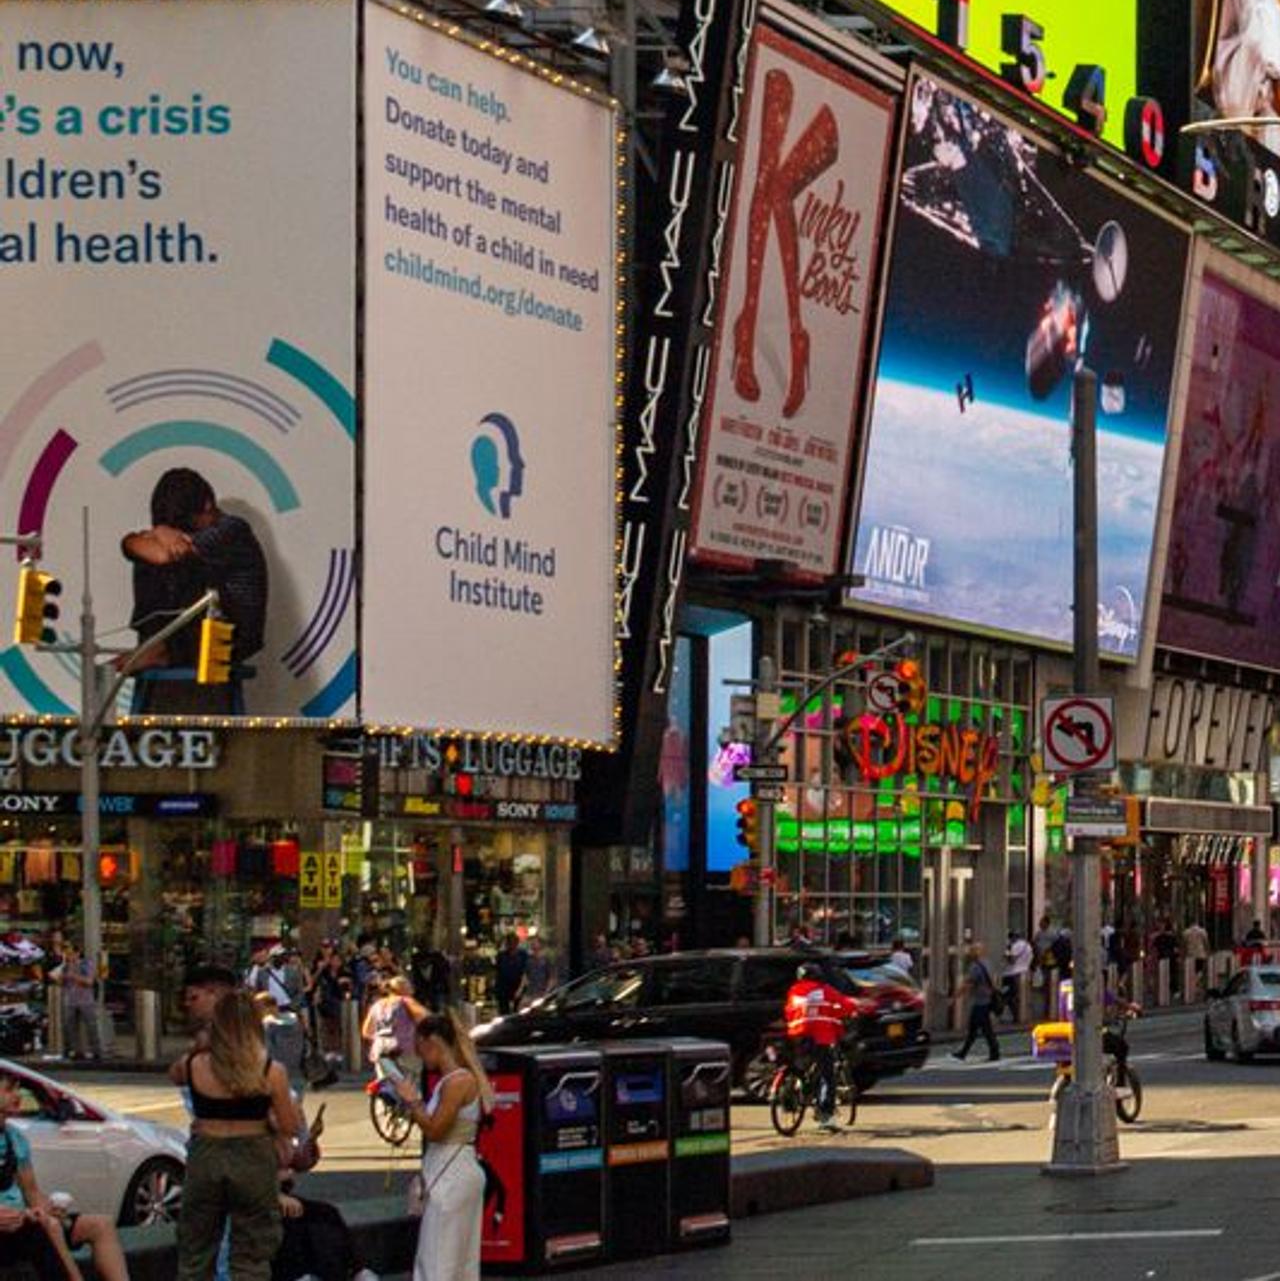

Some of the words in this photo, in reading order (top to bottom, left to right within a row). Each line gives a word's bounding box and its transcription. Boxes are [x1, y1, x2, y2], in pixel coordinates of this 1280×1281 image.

[17, 40, 124, 78] now,
[385, 46, 421, 85] You
[427, 72, 462, 103] can
[467, 83, 512, 123] help.
[55, 106, 82, 134] a
[97, 94, 231, 135] crisis
[385, 96, 457, 148] Donate
[461, 130, 513, 176] today
[516, 154, 549, 184] and
[385, 152, 462, 199] support
[467, 180, 496, 211] the
[501, 196, 561, 234] mental
[56, 224, 218, 263] health.
[385, 194, 448, 241] health
[452, 223, 472, 248] of
[476, 234, 487, 254] a
[490, 236, 535, 270] child
[539, 251, 555, 278] in
[558, 263, 600, 293] need
[384, 247, 583, 332] childmind.org/donate
[435, 526, 498, 566] Child
[502, 537, 556, 579] Mind
[864, 524, 930, 589] ANDOR
[449, 570, 544, 616] Institute
[463, 739, 582, 780] LUGGAGE
[497, 803, 540, 818] SONY
